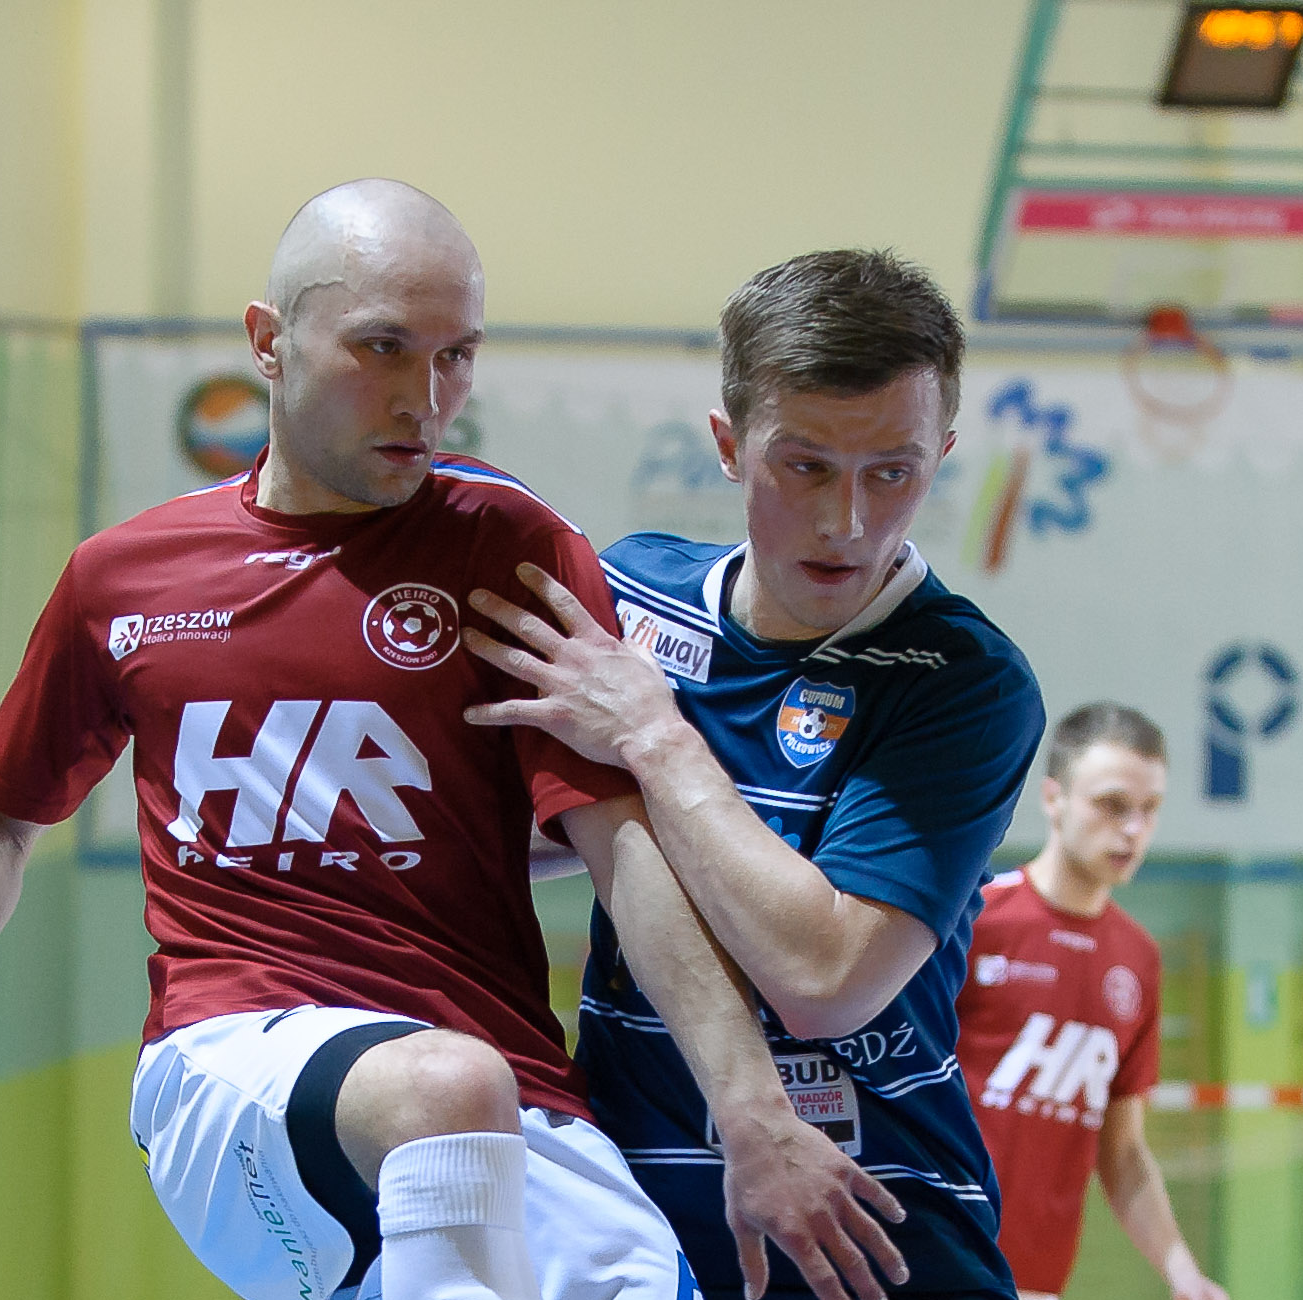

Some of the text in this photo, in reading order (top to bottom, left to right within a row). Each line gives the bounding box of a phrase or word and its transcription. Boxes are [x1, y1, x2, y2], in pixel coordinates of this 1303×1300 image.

[244, 546, 341, 571] reg
[391, 589, 440, 604] HEIRO
[145, 609, 234, 634] rzeszów
[142, 629, 231, 645] stolica innowacji
[630, 615, 710, 677] fitway
[382, 646, 439, 664] RZESZÓW 2007
[799, 689, 846, 710] CUPRUM
[783, 733, 832, 755] POLKOWICE
[177, 845, 422, 872] HEIRO
[778, 1060, 841, 1086] BUD
[798, 1089, 843, 1104] NADZÓR
